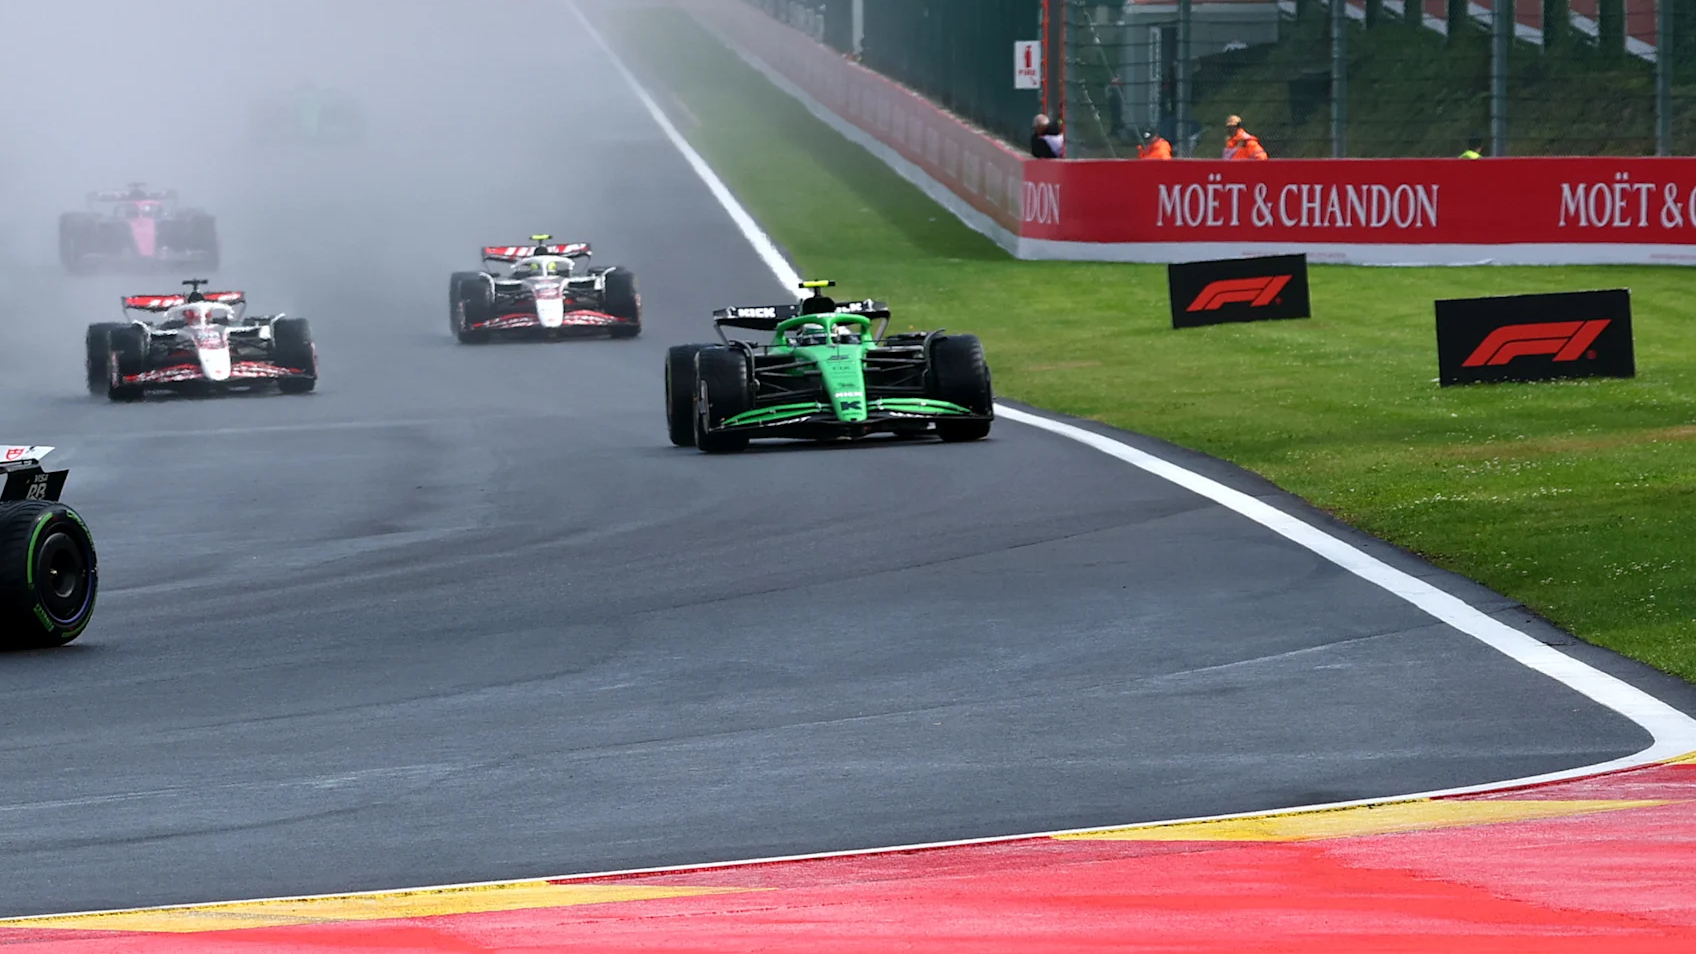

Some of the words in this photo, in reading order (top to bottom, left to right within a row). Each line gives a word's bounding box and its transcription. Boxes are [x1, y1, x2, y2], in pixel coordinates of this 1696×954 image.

[1156, 173, 1246, 226] MOËT
[1252, 183, 1274, 227] &
[1279, 183, 1440, 228] CHANDON
[1558, 172, 1656, 228] MOËT
[1660, 182, 1684, 228] &
[738, 307, 776, 317] KICK
[1185, 274, 1292, 311] F1
[1461, 319, 1612, 367] F1
